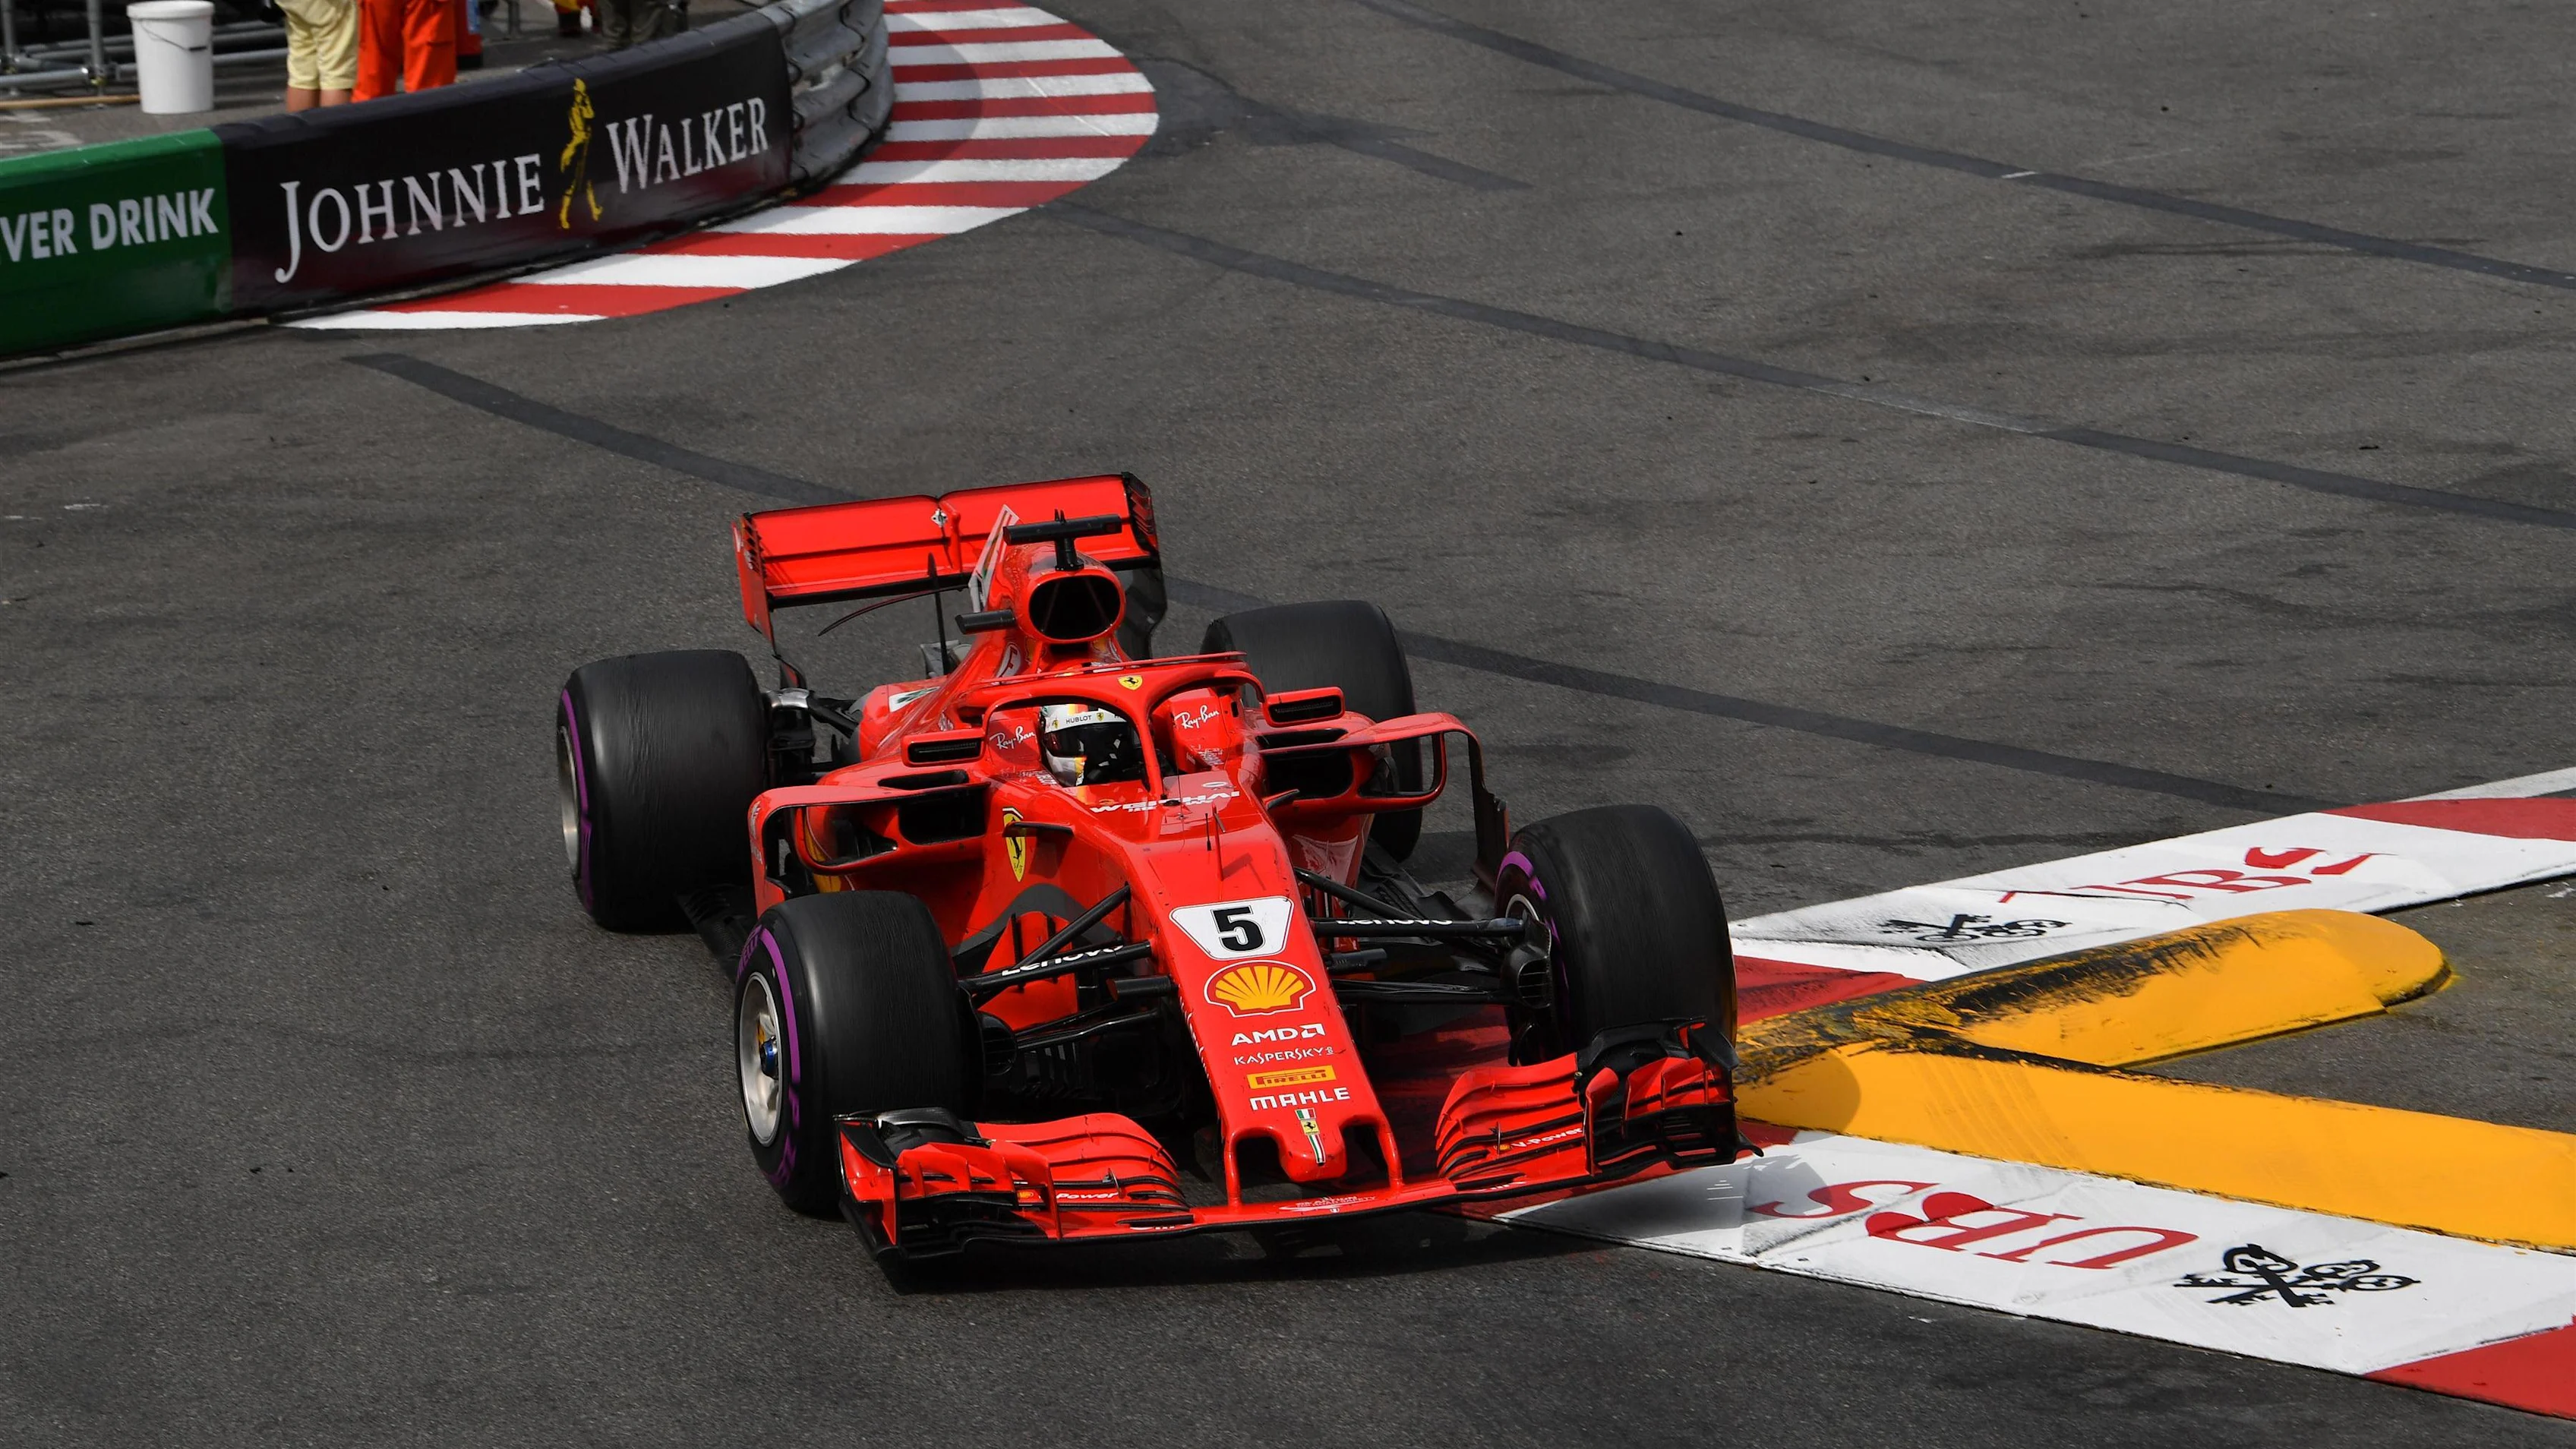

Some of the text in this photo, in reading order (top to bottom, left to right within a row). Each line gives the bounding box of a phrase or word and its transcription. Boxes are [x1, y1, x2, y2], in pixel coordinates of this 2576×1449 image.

[274, 96, 769, 283] JOHNNIE WALKER
[0, 188, 219, 262] VER DRINK
[1065, 715, 1092, 724] HUBLOT
[1173, 705, 1220, 729] Ray-Ban
[989, 725, 1035, 750] Ray-Ban
[1210, 904, 1266, 952] 5
[1231, 1028, 1299, 1046] AMD
[1233, 1046, 1324, 1065] KASPERSKY
[1255, 1069, 1327, 1086] PIRELLI
[1249, 1087, 1351, 1111] MAHLE
[1511, 1127, 1583, 1148] V-Power
[1751, 1178, 2200, 1271] UBS
